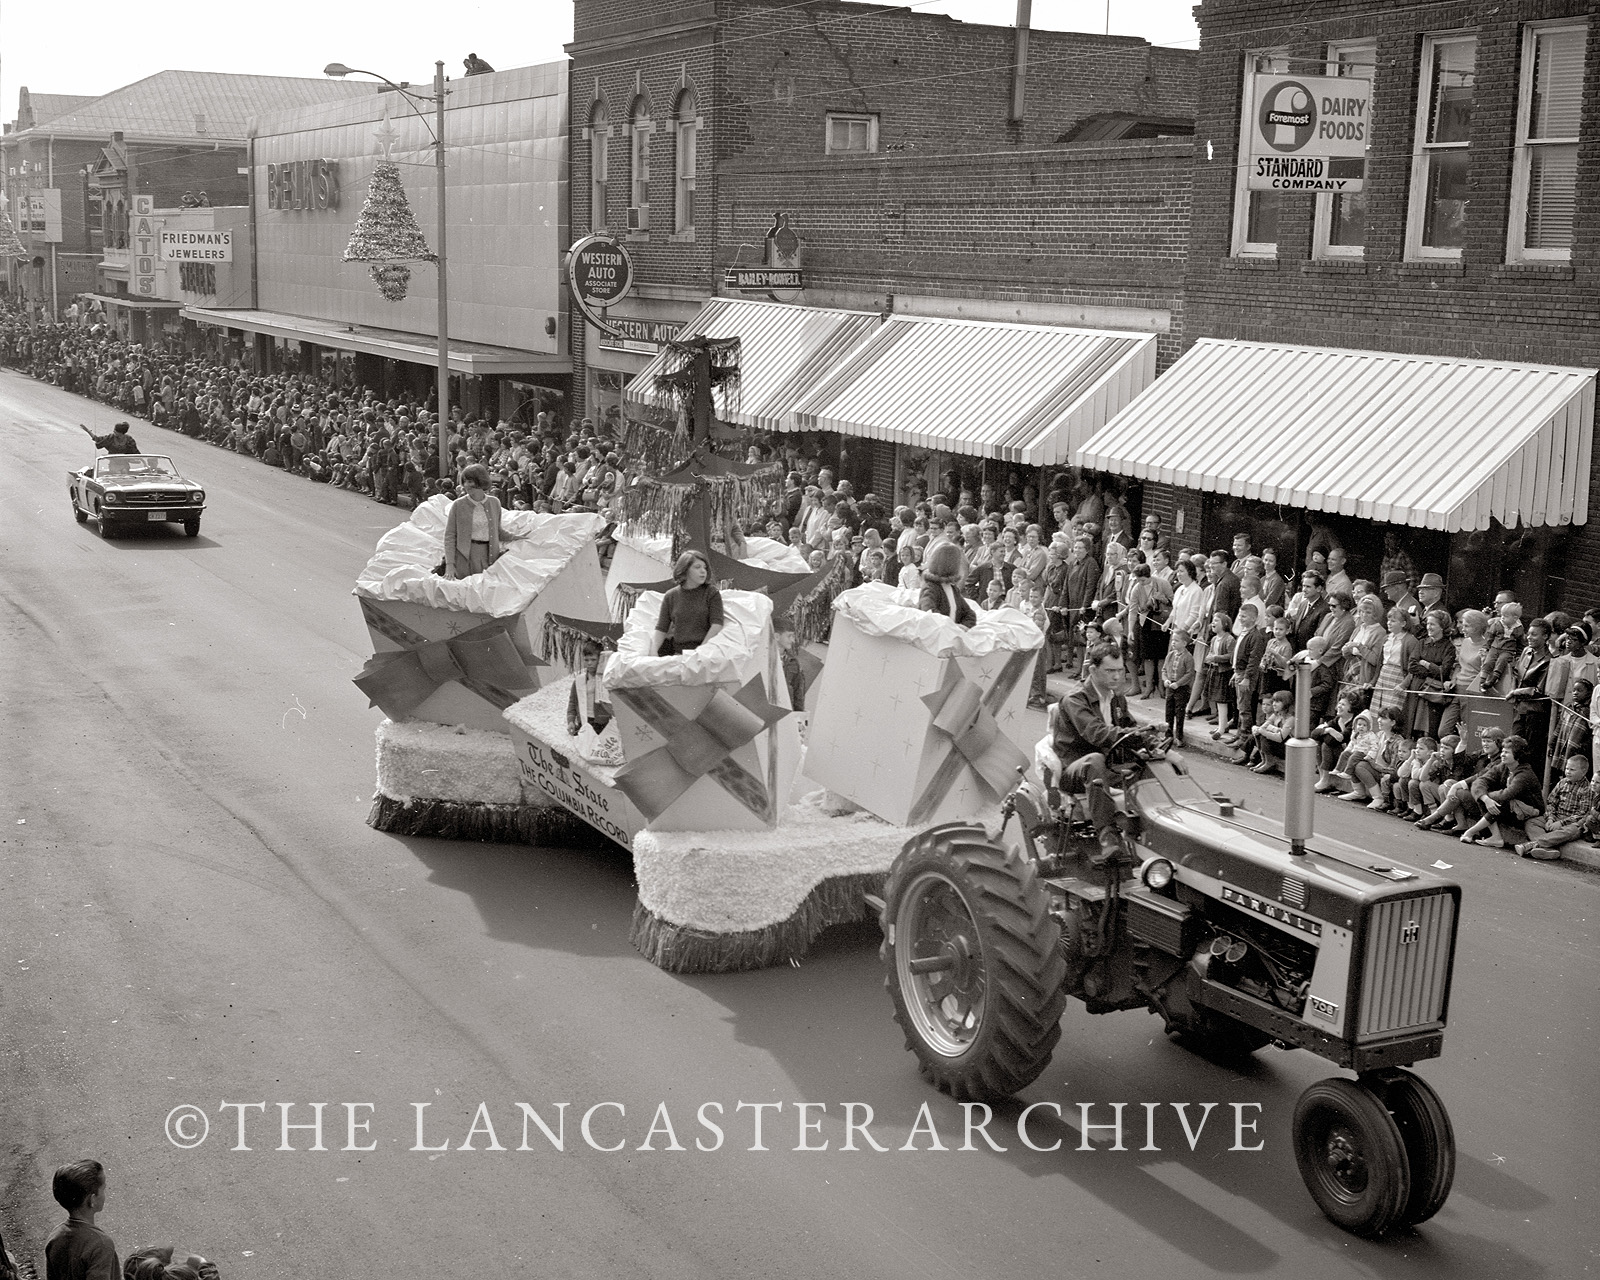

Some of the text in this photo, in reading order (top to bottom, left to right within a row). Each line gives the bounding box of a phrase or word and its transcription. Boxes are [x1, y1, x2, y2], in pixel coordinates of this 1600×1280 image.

[1321, 97, 1366, 117] DAIRY
[1269, 112, 1309, 124] Foremost
[1319, 121, 1364, 140] FOODS
[1256, 157, 1323, 178] STANDARD
[1272, 178, 1347, 189] COMPANY
[162, 233, 230, 245] FRIEDMAN'S
[168, 250, 225, 259] JEWELERS
[581, 252, 622, 266] WESTERN
[588, 267, 616, 279] AUTO
[527, 741, 610, 813] The State
[518, 758, 629, 845] THE COLUMBIA RECORD
[1224, 889, 1319, 935] FARMALL
